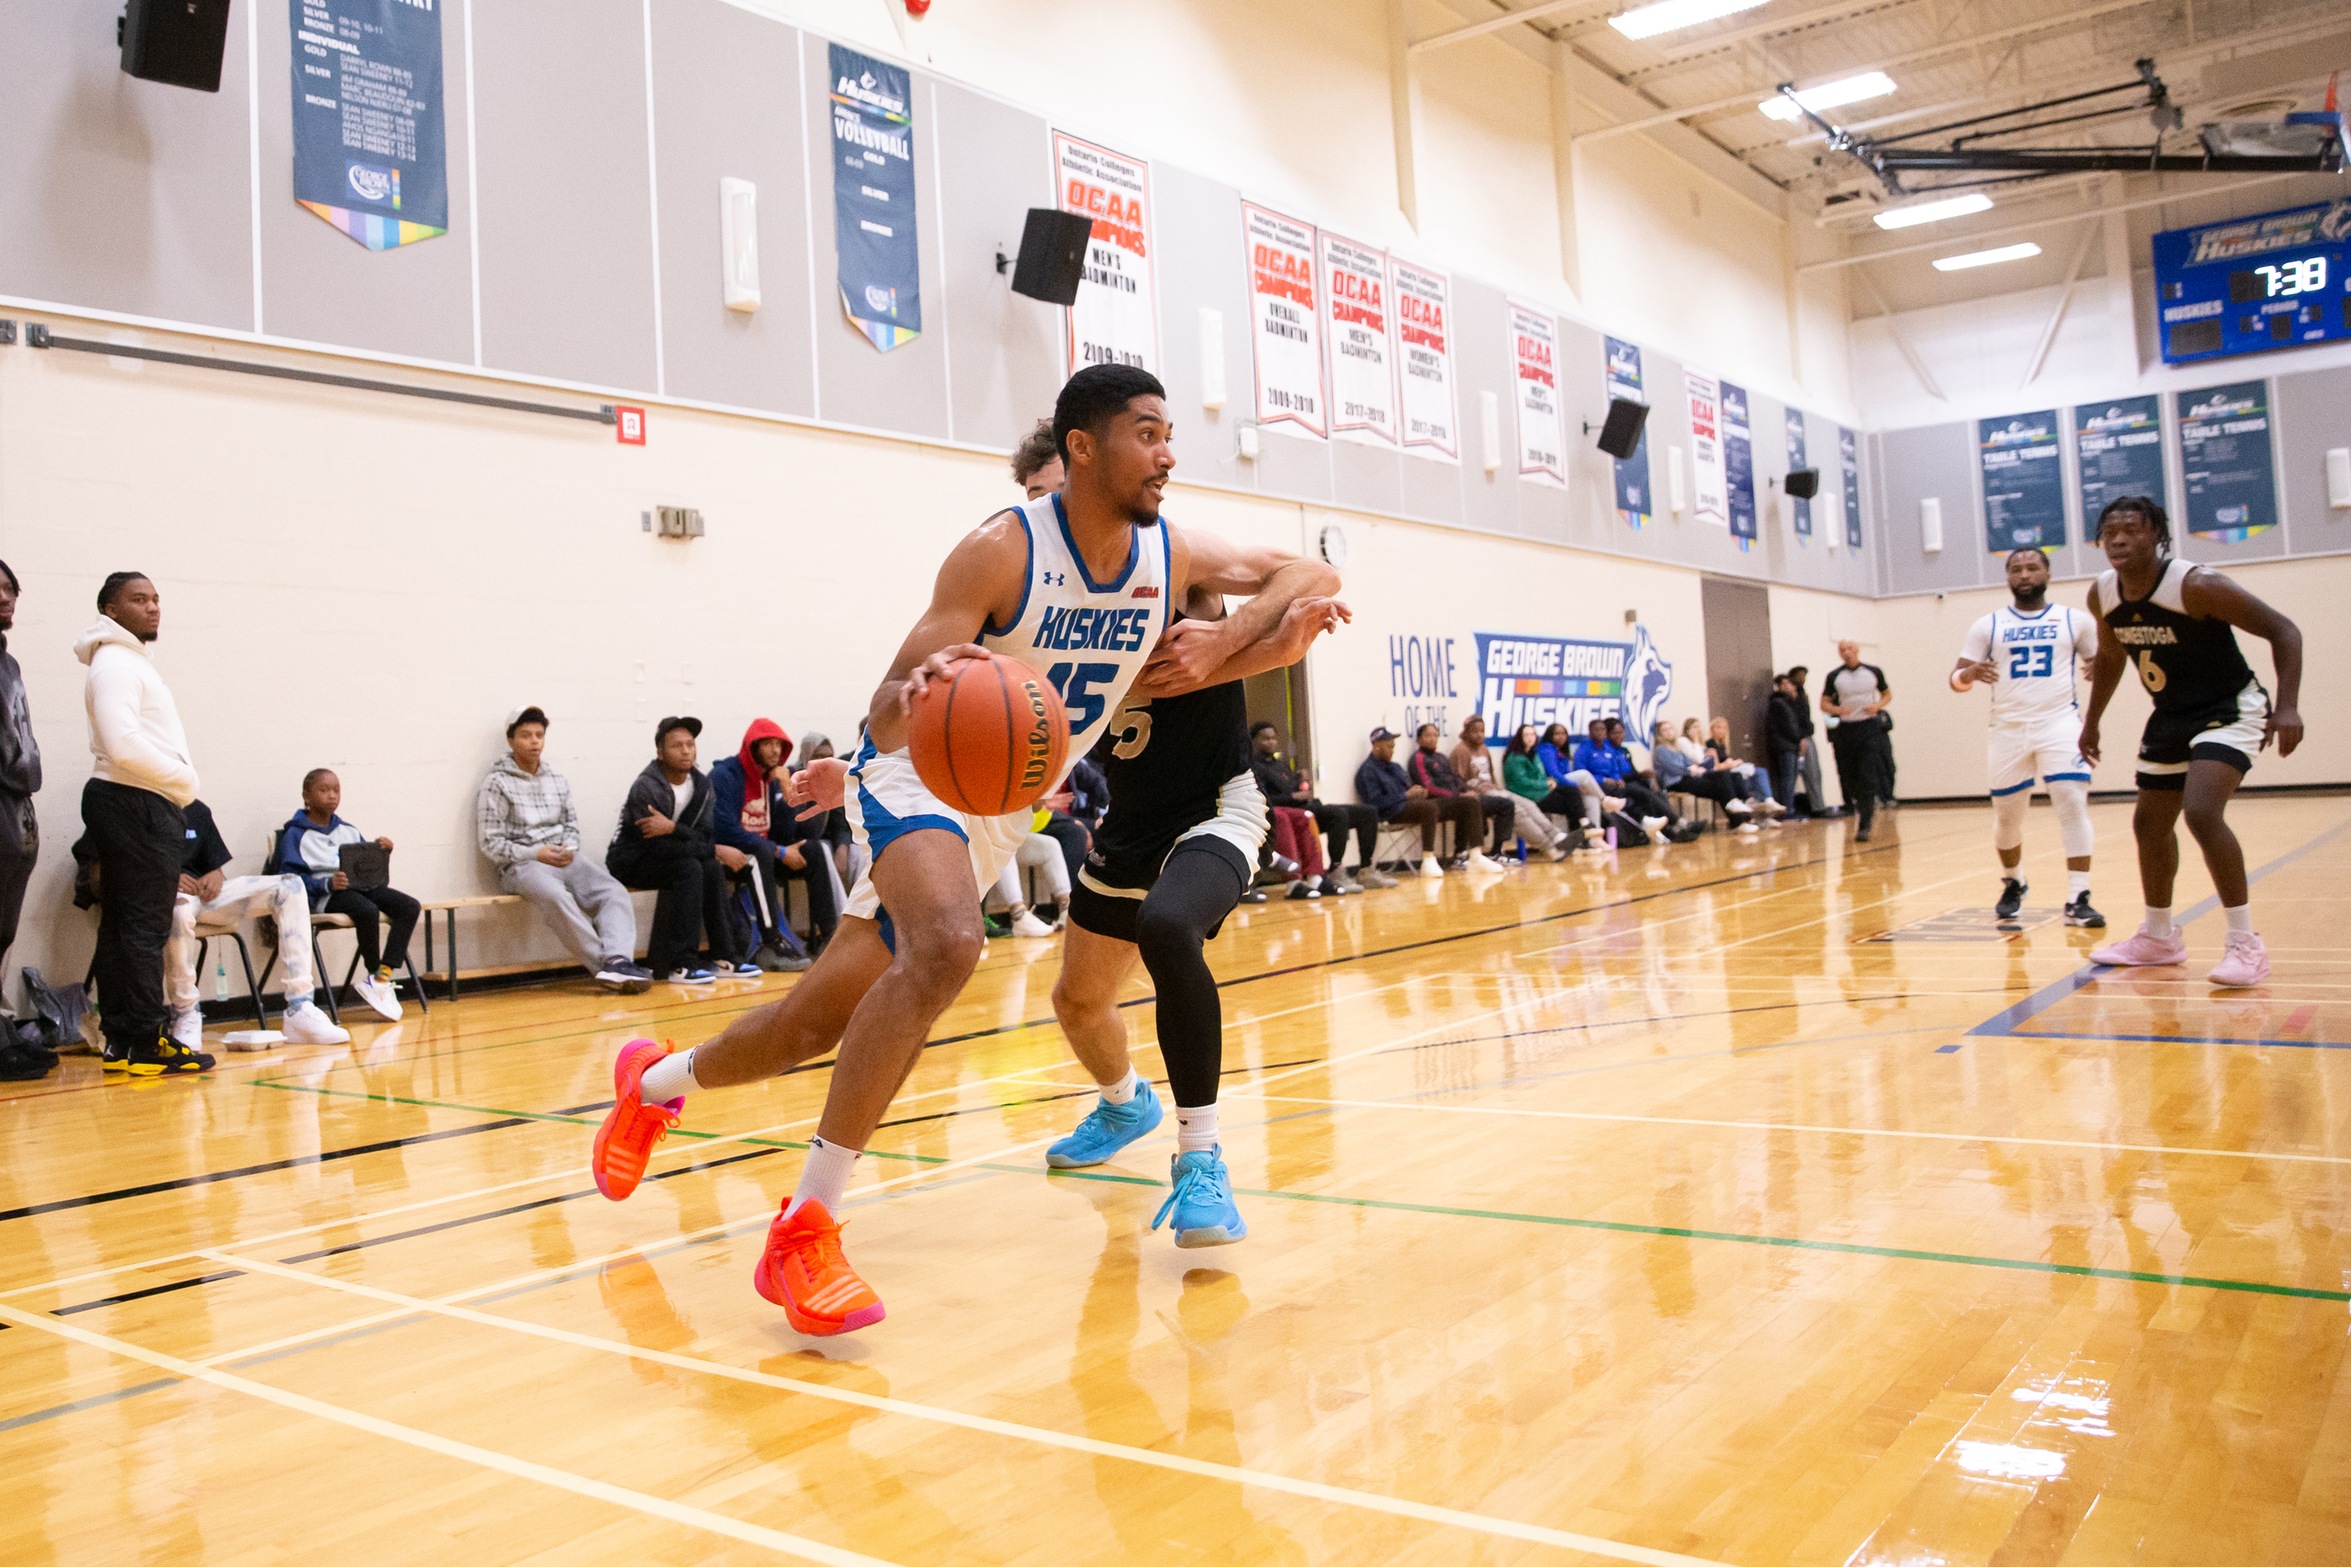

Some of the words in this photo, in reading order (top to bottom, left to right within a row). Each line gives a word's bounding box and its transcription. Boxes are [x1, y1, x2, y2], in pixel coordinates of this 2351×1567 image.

[303, 6, 329, 20] SILVER
[304, 17, 335, 34] BRONZE
[298, 29, 360, 55] INDIVIDUAL
[304, 44, 327, 57] GOLD
[305, 64, 331, 79] SILVER
[305, 94, 336, 109] BRONZE
[837, 76, 903, 114] HUSKIES
[834, 117, 909, 161] VOLLEYBALL
[1068, 145, 1098, 163] Ontario
[1100, 157, 1134, 177] Colleges
[1096, 169, 1142, 192] Association
[1067, 178, 1143, 229] OCAA
[1093, 248, 1120, 270] MEN'S
[2194, 229, 2313, 262] HUSKIES
[1254, 243, 1311, 284] OCAA
[2254, 256, 2326, 297] 7:38
[1333, 269, 1382, 309] OCAA
[1270, 302, 1300, 324] OVERALL
[1333, 300, 1384, 334] CHAMPIONS
[1401, 293, 1443, 331] OCAA
[2164, 299, 2223, 322] HUSKIES
[1265, 318, 1308, 343] BADMINTON
[1349, 328, 1372, 347] MEN'S
[1401, 323, 1445, 355] CHAMPIONS
[1341, 341, 1382, 364] BADMINTON
[1518, 335, 1552, 368] OCAA
[1408, 361, 1442, 382] BADMINTON
[1345, 401, 1384, 423] 2017-2018
[2080, 436, 2116, 450] TABLE
[2118, 430, 2159, 447] TENNIS
[2182, 424, 2221, 440] TABLE
[2222, 417, 2267, 435] TENNIS
[1983, 450, 2018, 464] TABLE
[2019, 444, 2058, 460] TENNIS
[1131, 586, 1159, 599] OCAA
[1032, 605, 1150, 652] HUSKIES
[2003, 625, 2058, 643] HUSKIES
[1390, 635, 1457, 698] HOME
[1487, 640, 1562, 676] GEORGE
[1563, 644, 1625, 678] BROWN
[2010, 645, 2053, 679] 23
[2138, 650, 2166, 692] 6
[1021, 680, 1050, 791] Wilson
[1110, 694, 1153, 760] 5
[1405, 704, 1421, 738] OF
[1425, 705, 1447, 738] THE
